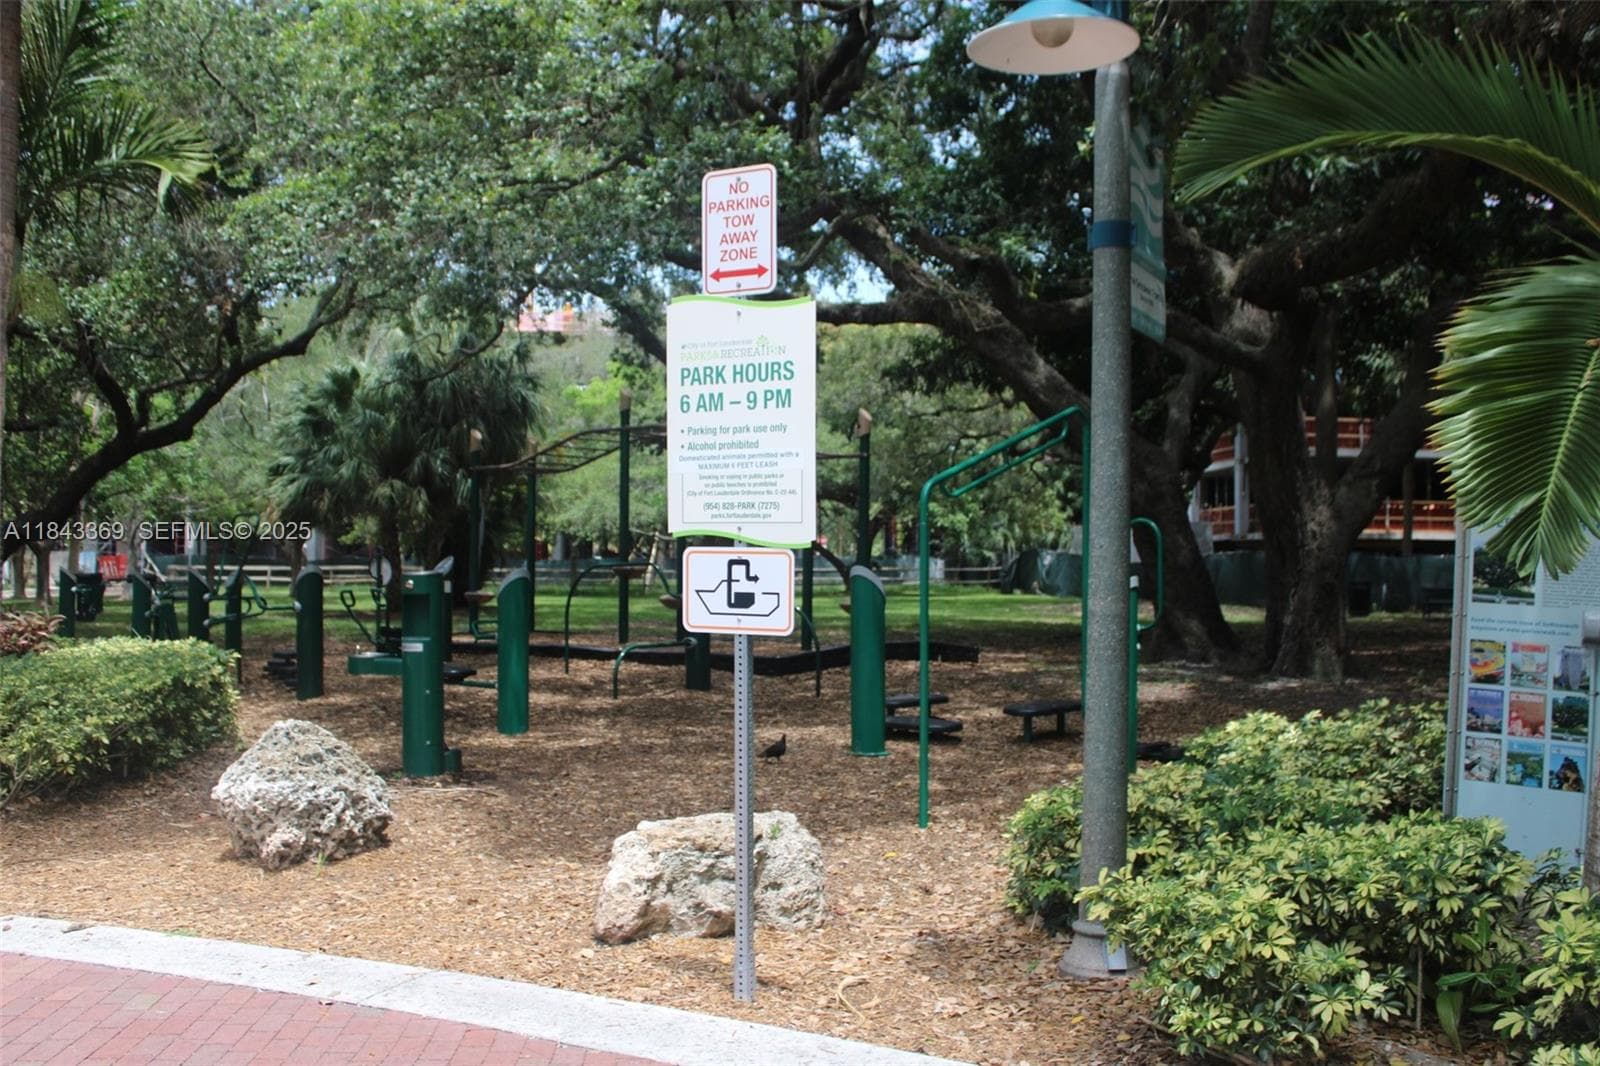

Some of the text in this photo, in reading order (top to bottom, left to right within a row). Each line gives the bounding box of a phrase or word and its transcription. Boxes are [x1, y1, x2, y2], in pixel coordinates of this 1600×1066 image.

[729, 181, 749, 194] NO
[708, 195, 770, 214] PARKING
[723, 214, 755, 228] TOW
[719, 230, 759, 246] AWAY
[719, 247, 758, 263] ZONE
[680, 360, 795, 387] PARK HOURS
[680, 394, 691, 414] 6
[696, 391, 724, 413] AM
[746, 390, 758, 411] 9
[763, 388, 792, 409] PM
[687, 422, 788, 437] Parking for park use only
[687, 439, 760, 452] Alcohol prohibited
[678, 453, 720, 463] Domesticated
[722, 453, 746, 461] animals
[747, 452, 778, 461] permitted
[780, 451, 794, 459] with
[698, 462, 730, 471] MAXIMUM
[737, 461, 754, 470] FEET
[755, 460, 779, 469] LEASH
[703, 500, 780, 512] (954) 828-PARK (7275)
